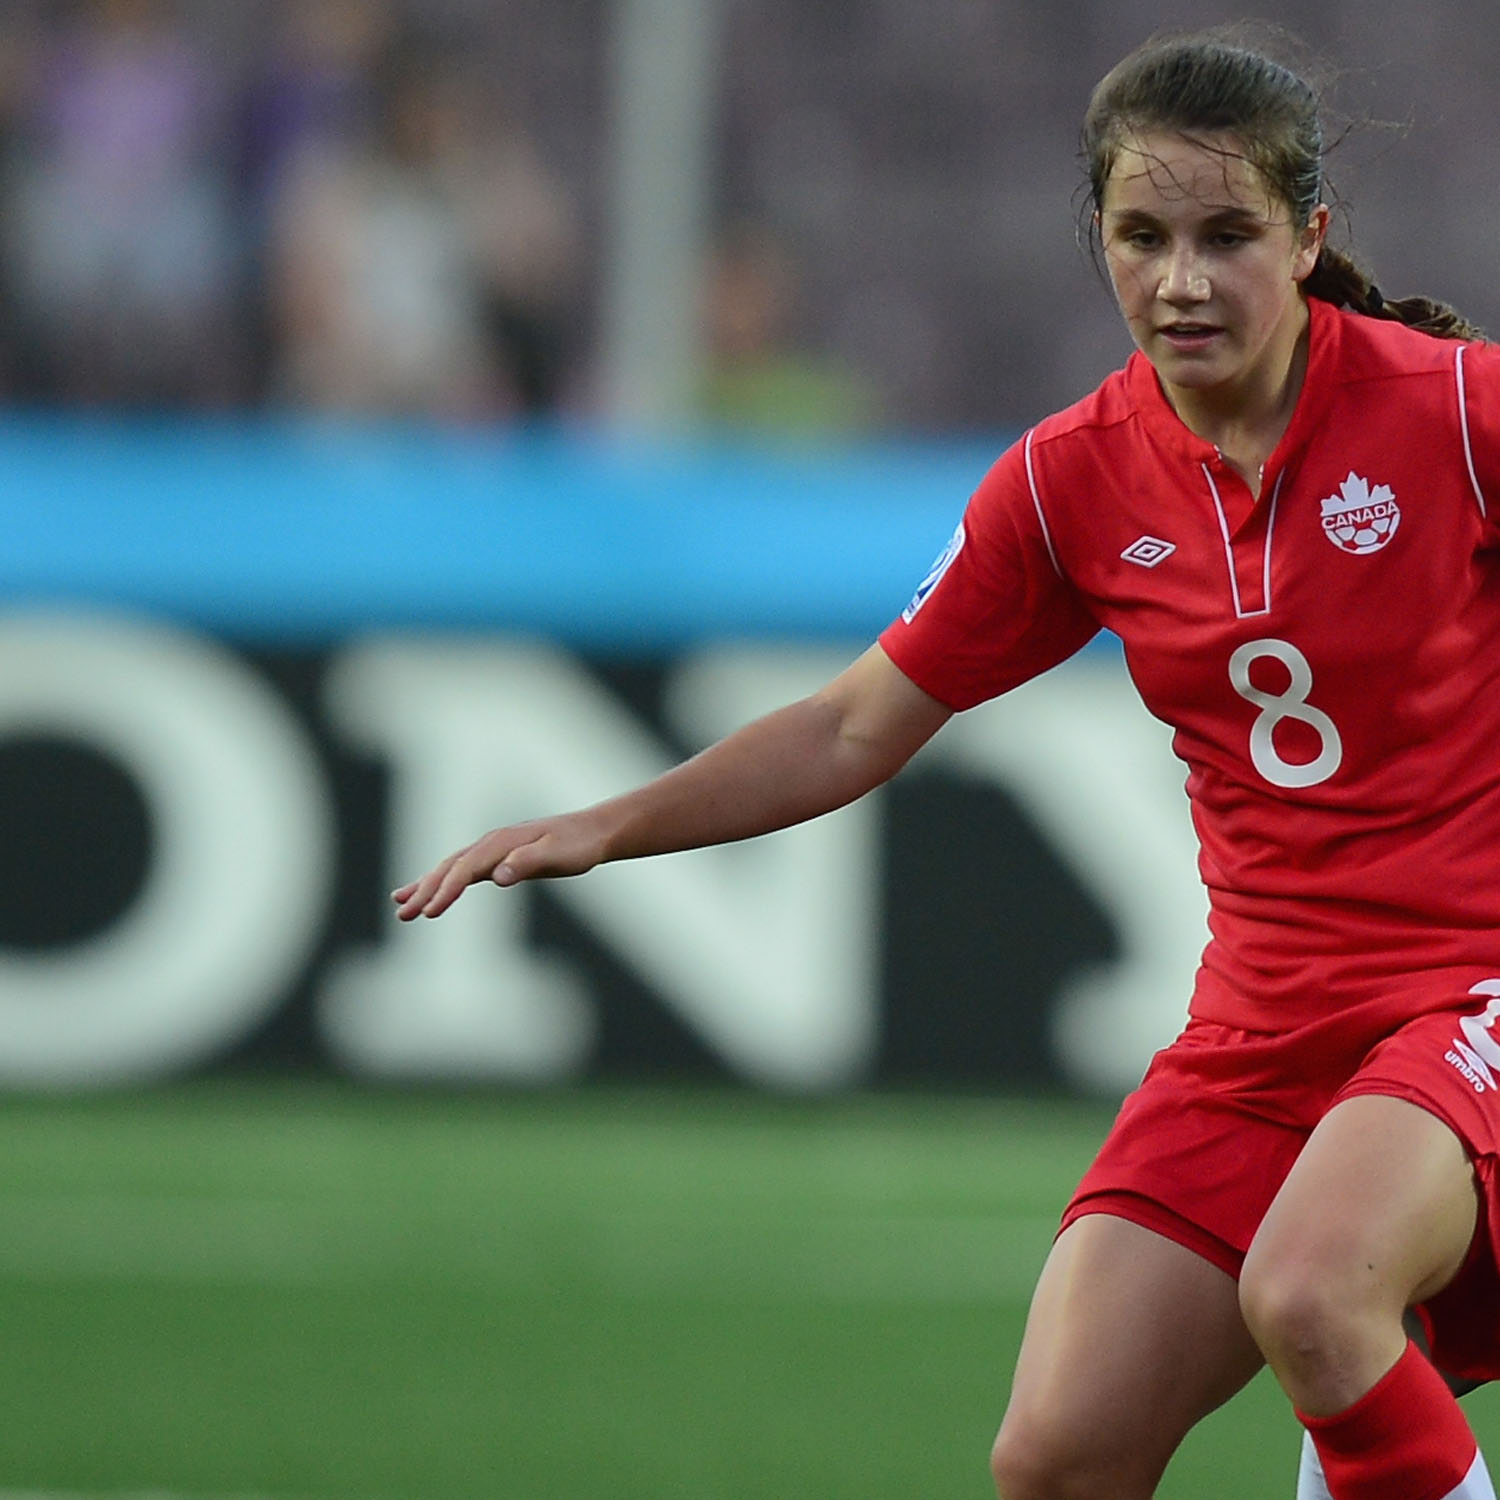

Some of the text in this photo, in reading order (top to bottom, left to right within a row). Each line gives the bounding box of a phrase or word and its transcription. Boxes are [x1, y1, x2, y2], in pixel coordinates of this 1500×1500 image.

[1321, 500, 1400, 530] CANADA
[1228, 638, 1343, 789] 8
[1443, 1050, 1486, 1093] umbro
